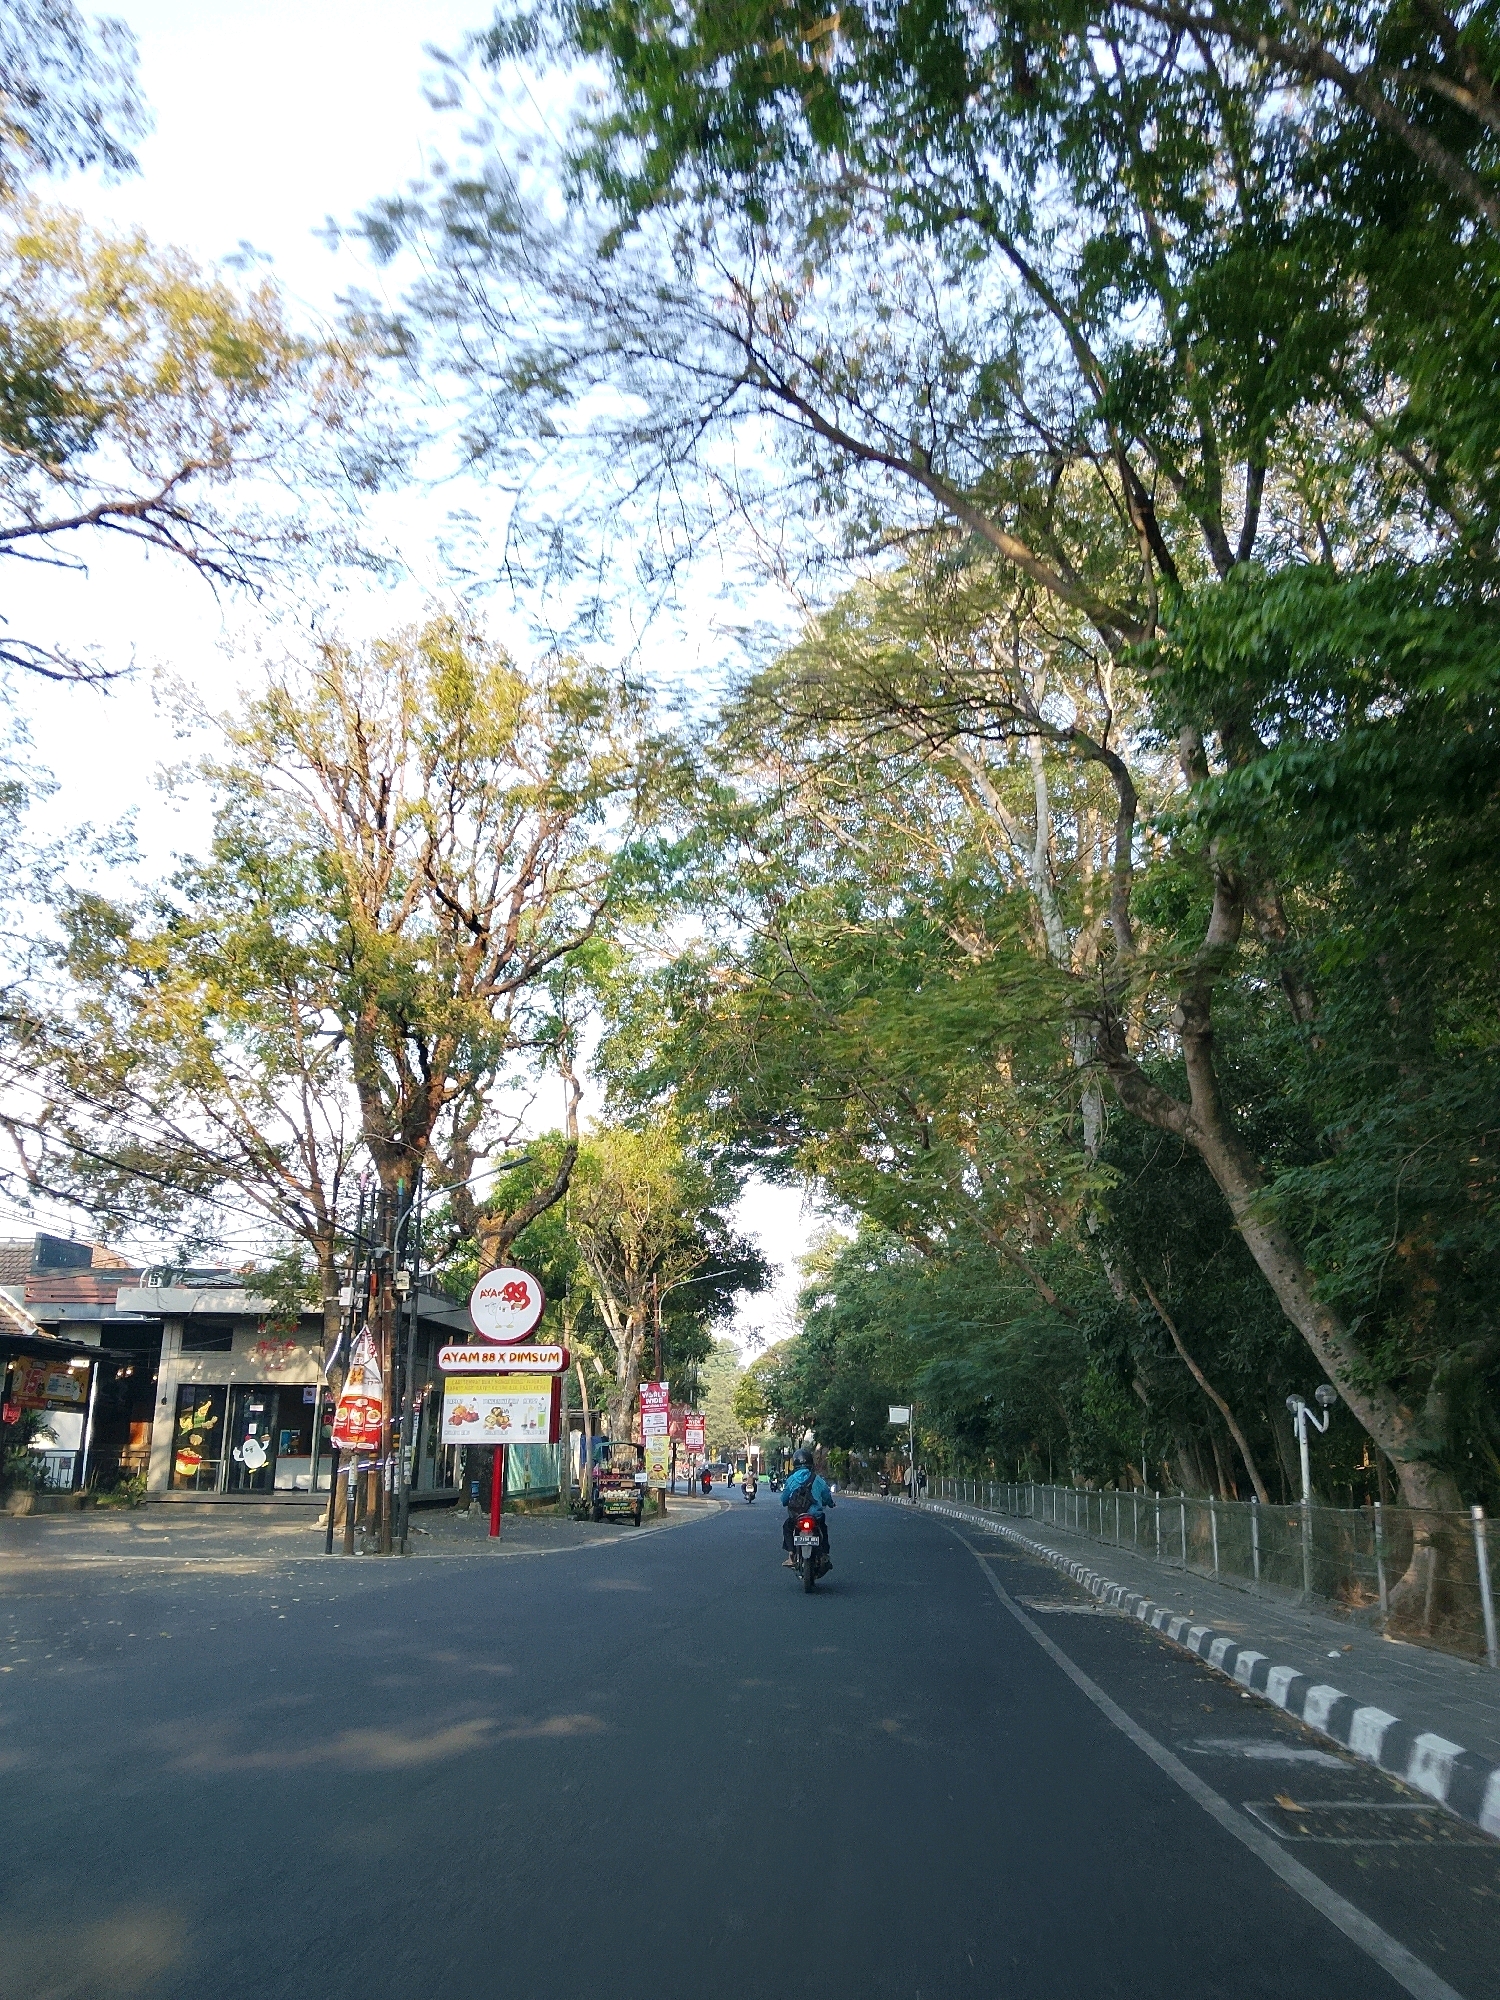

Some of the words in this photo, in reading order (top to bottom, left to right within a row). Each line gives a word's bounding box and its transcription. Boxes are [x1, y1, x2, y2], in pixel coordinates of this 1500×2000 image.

[480, 1287, 508, 1299] AYAM
[441, 1352, 479, 1363] AYAM
[482, 1352, 495, 1362] 88
[498, 1352, 506, 1363] X
[509, 1352, 559, 1363] DIMSUM
